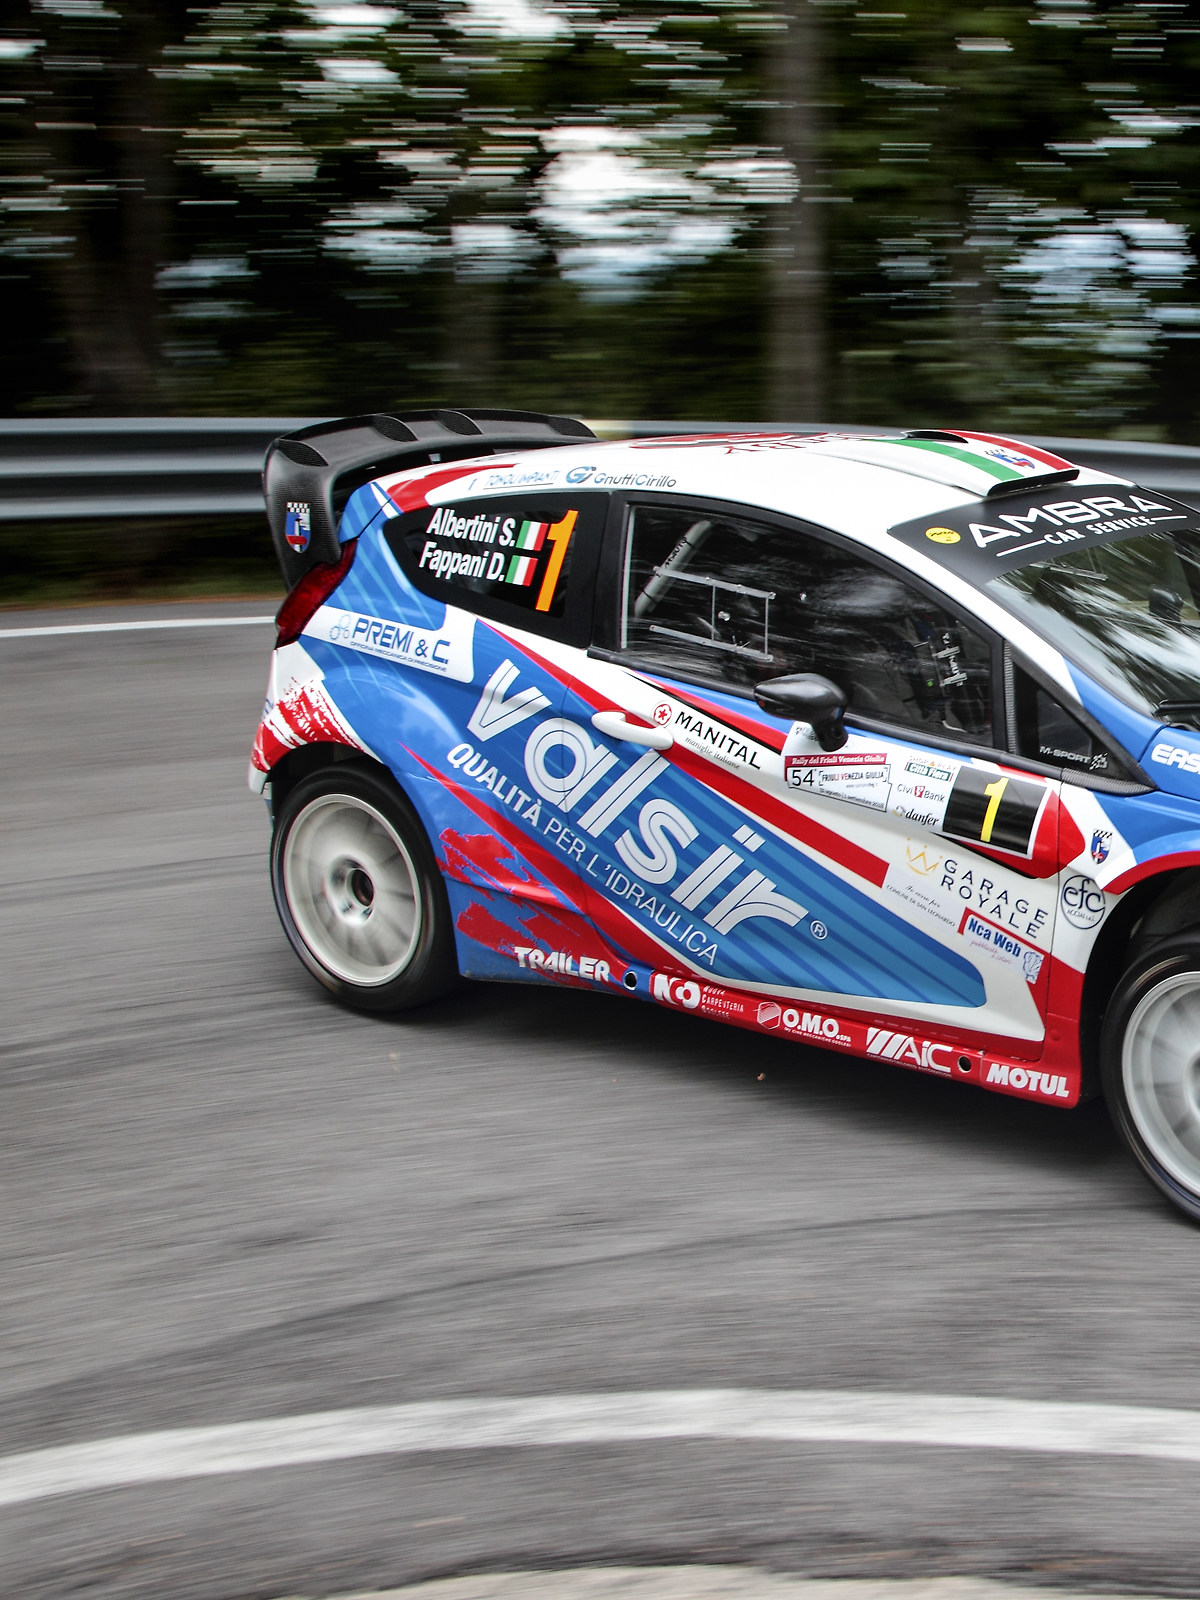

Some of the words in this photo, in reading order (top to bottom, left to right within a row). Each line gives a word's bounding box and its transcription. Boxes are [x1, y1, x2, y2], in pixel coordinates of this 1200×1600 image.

[594, 472, 677, 488] GnuttiCirillo
[426, 507, 501, 544] Albertini
[499, 517, 516, 547] S.
[968, 494, 1172, 548] AMBRA
[1044, 529, 1086, 545] CAR
[1092, 515, 1157, 535] SERVICE
[419, 541, 490, 580] Fappani
[486, 551, 506, 582] D.
[536, 509, 579, 612] 1
[352, 617, 414, 653] PREMI
[415, 639, 428, 658] &
[432, 639, 451, 665] C.
[674, 711, 761, 770] MANITAL
[1039, 746, 1091, 765] M-SPORT
[792, 757, 808, 766] Rally
[446, 743, 542, 827] QUALITÀ
[543, 817, 587, 861] PER
[924, 790, 945, 802] Bank
[980, 777, 1009, 842] 1
[905, 808, 940, 826] danfer
[940, 874, 1041, 939] ROYALE
[943, 858, 1049, 925] GARAGE
[968, 918, 991, 941] Nca
[993, 932, 1021, 957] Web
[514, 946, 611, 982] TRAILER
[986, 1063, 1070, 1098] MOTUL
